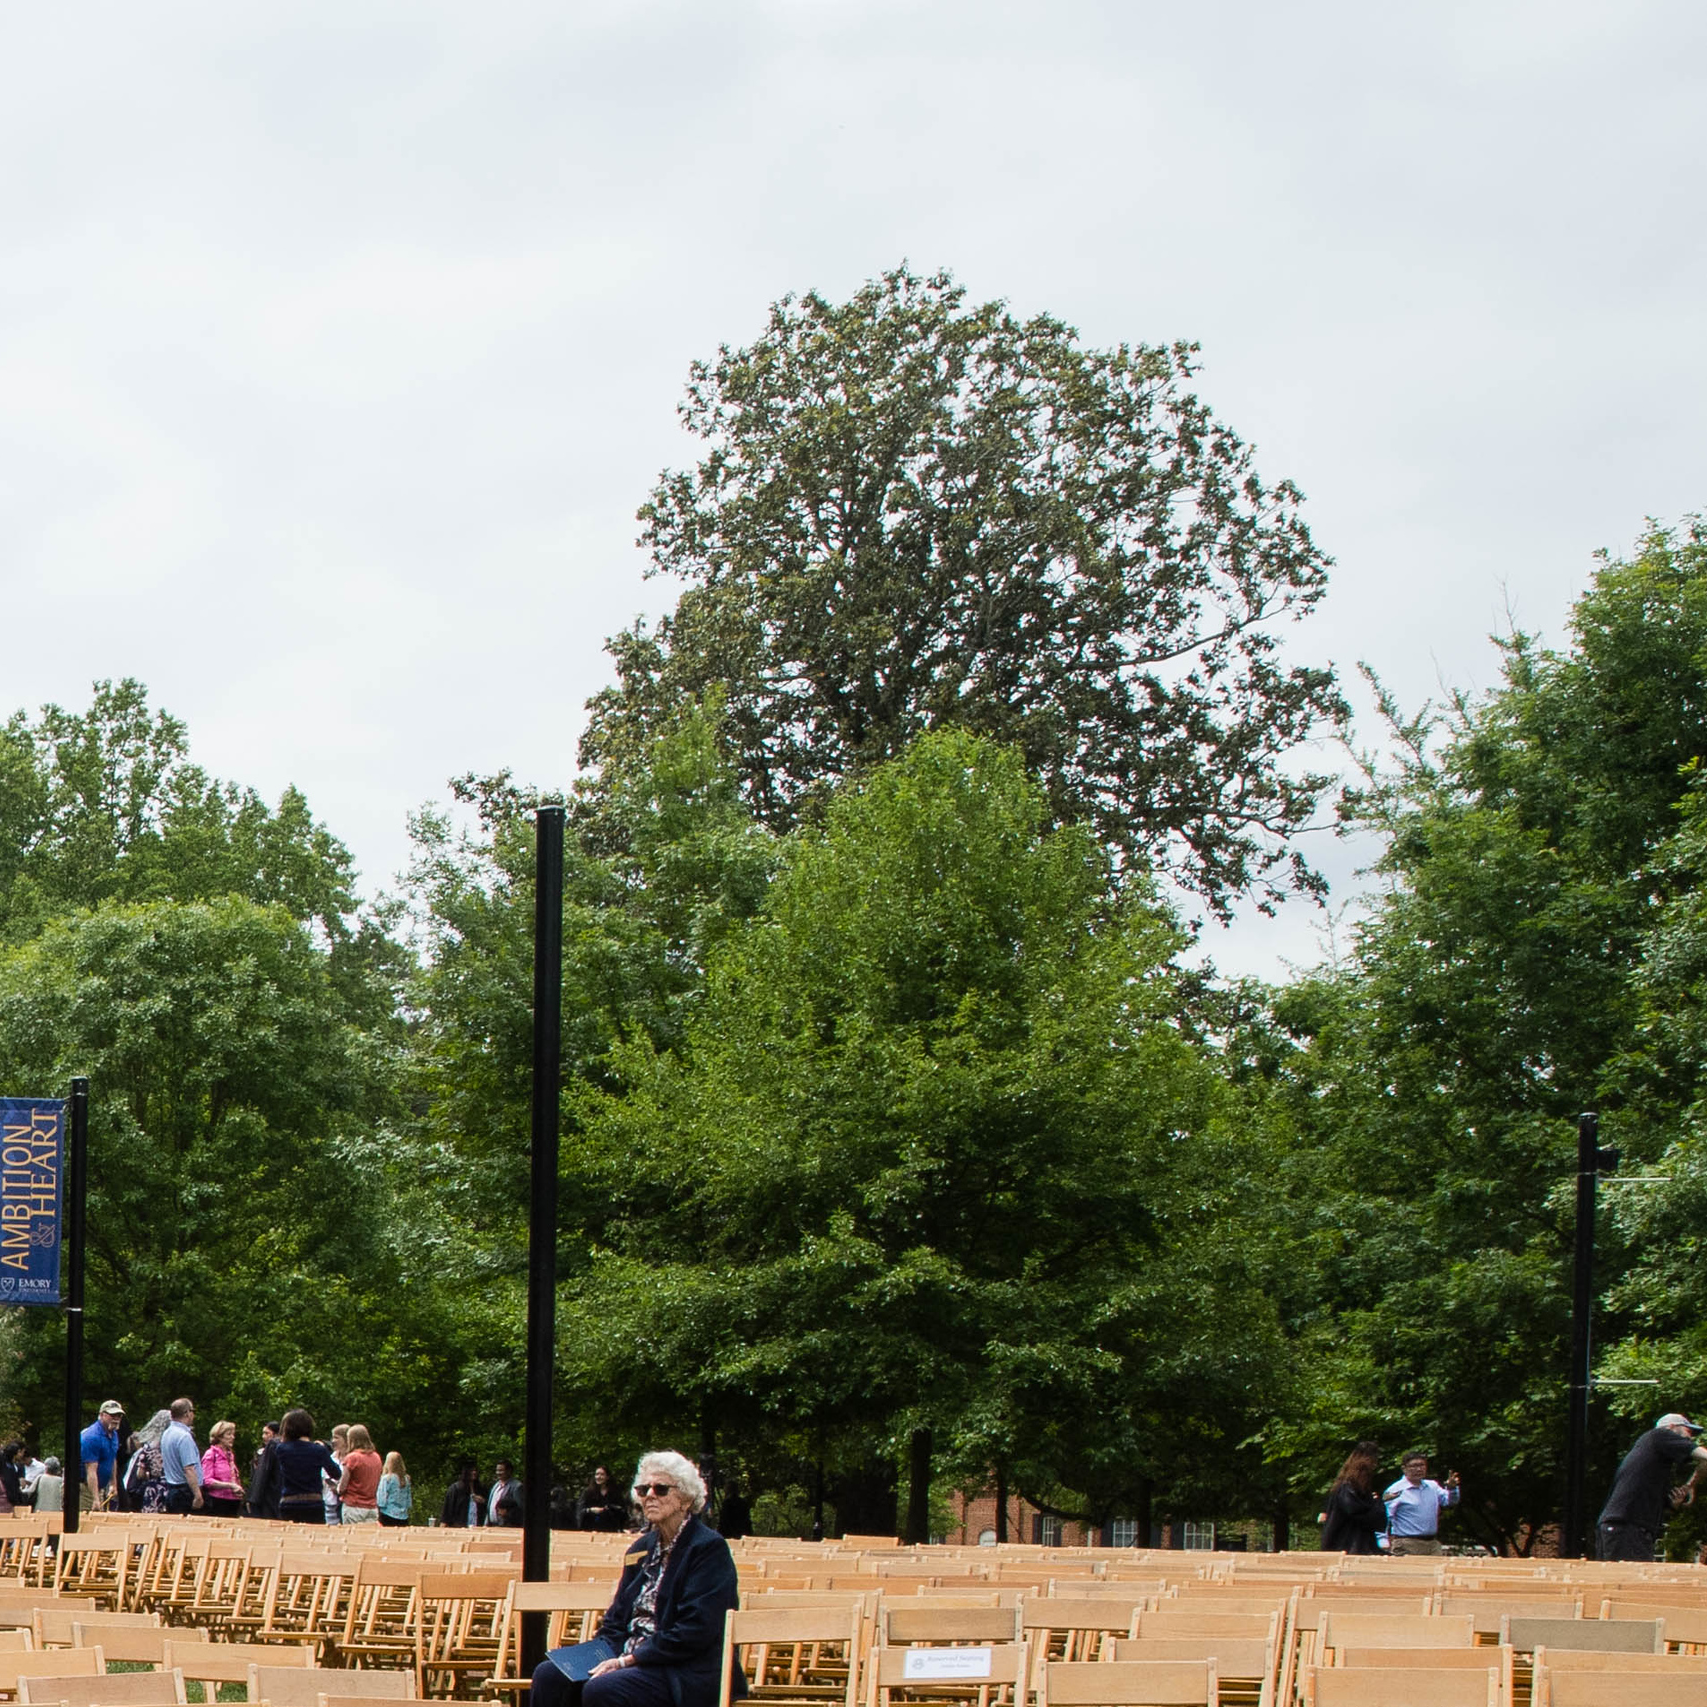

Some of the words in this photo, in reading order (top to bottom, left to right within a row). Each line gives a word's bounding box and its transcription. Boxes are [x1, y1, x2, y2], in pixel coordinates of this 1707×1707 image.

[29, 1108, 58, 1218] HEART
[0, 1125, 32, 1271] AMBITION
[29, 1223, 56, 1248] &
[18, 1278, 51, 1288] EMORY
